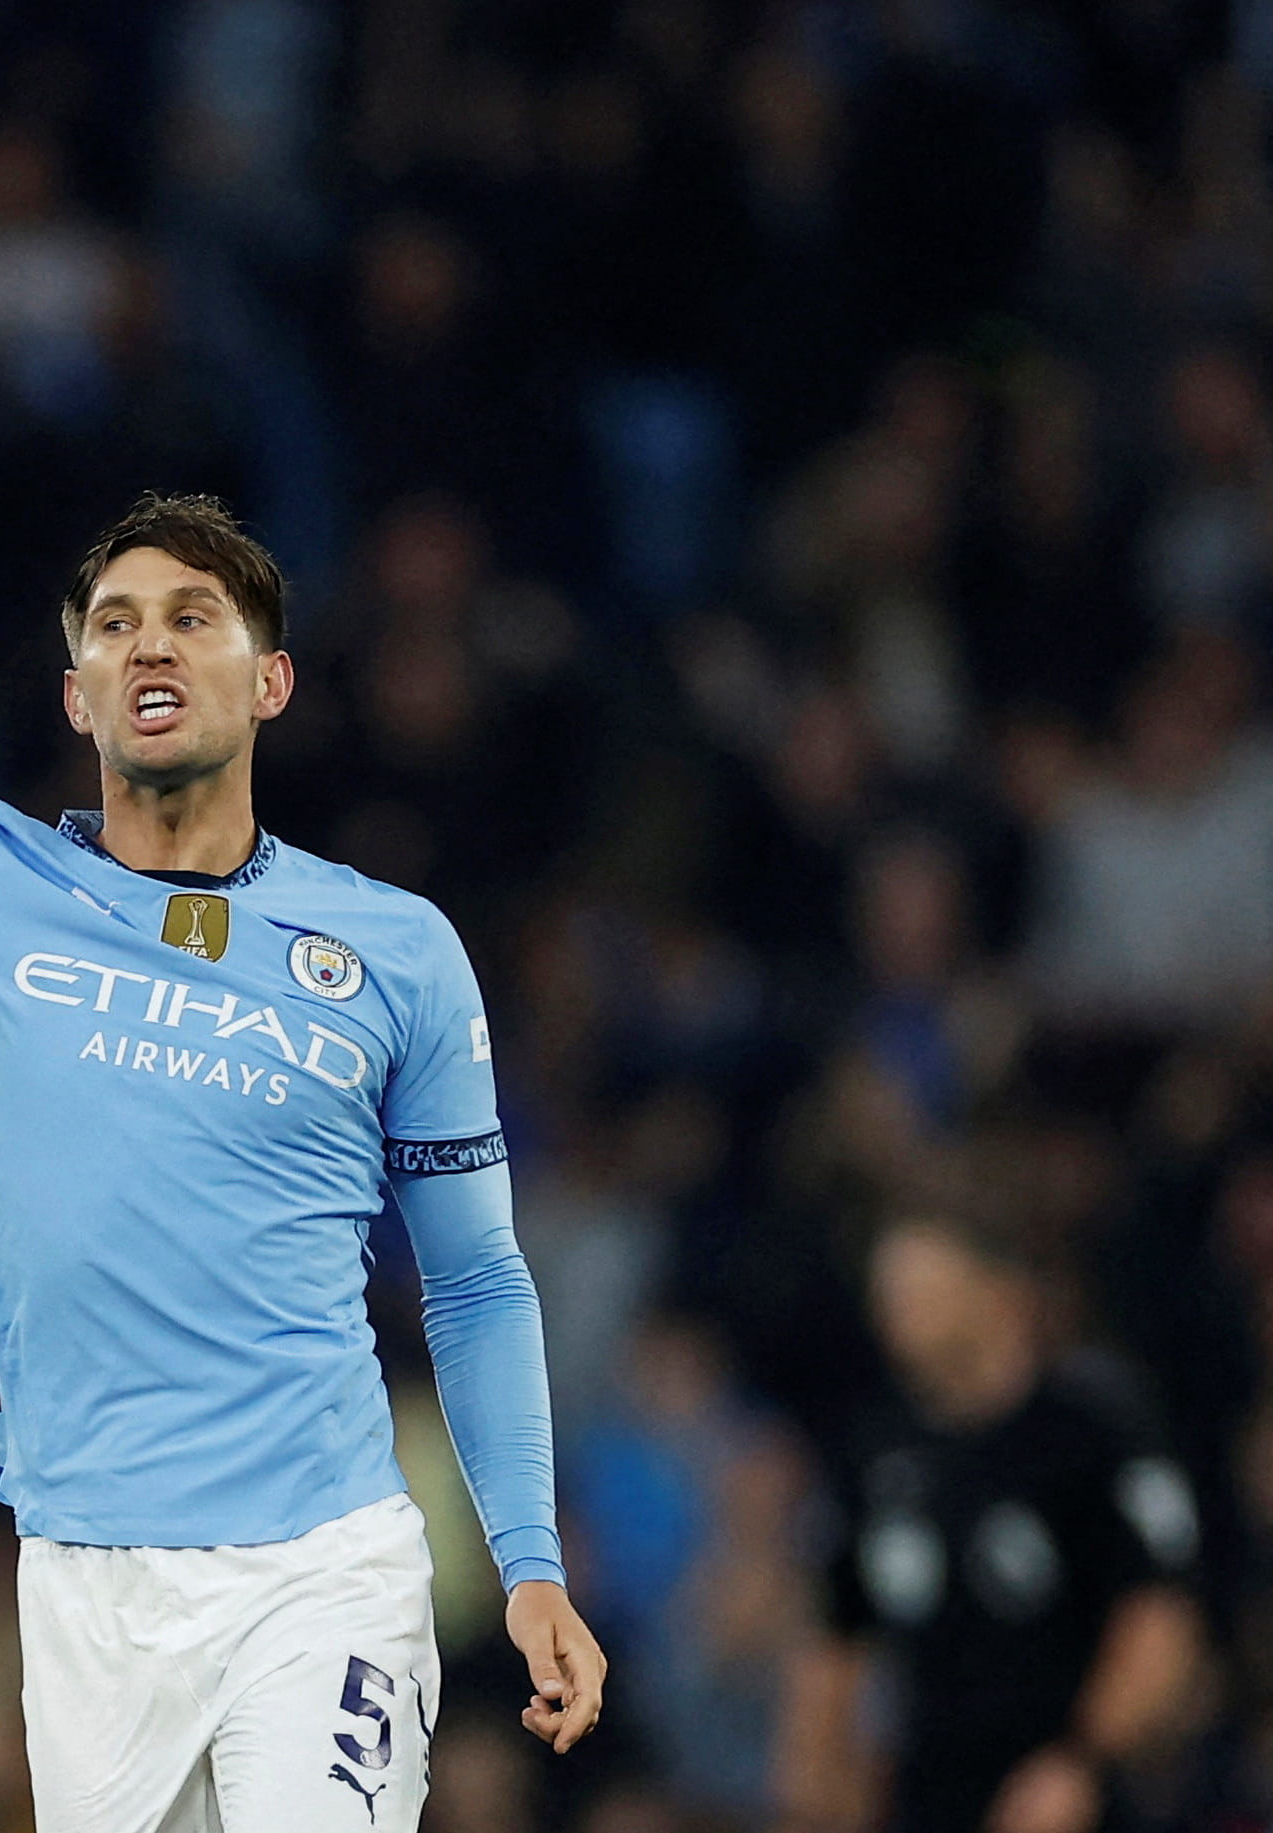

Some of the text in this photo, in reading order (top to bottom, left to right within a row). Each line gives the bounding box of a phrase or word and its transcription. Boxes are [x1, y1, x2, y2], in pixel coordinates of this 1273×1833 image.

[298, 936, 358, 966] MANCHESTER
[13, 951, 371, 1090] ETIHAD
[314, 985, 337, 997] CITY
[78, 1030, 292, 1107] AIRWAYS
[332, 1654, 396, 1771] 5
